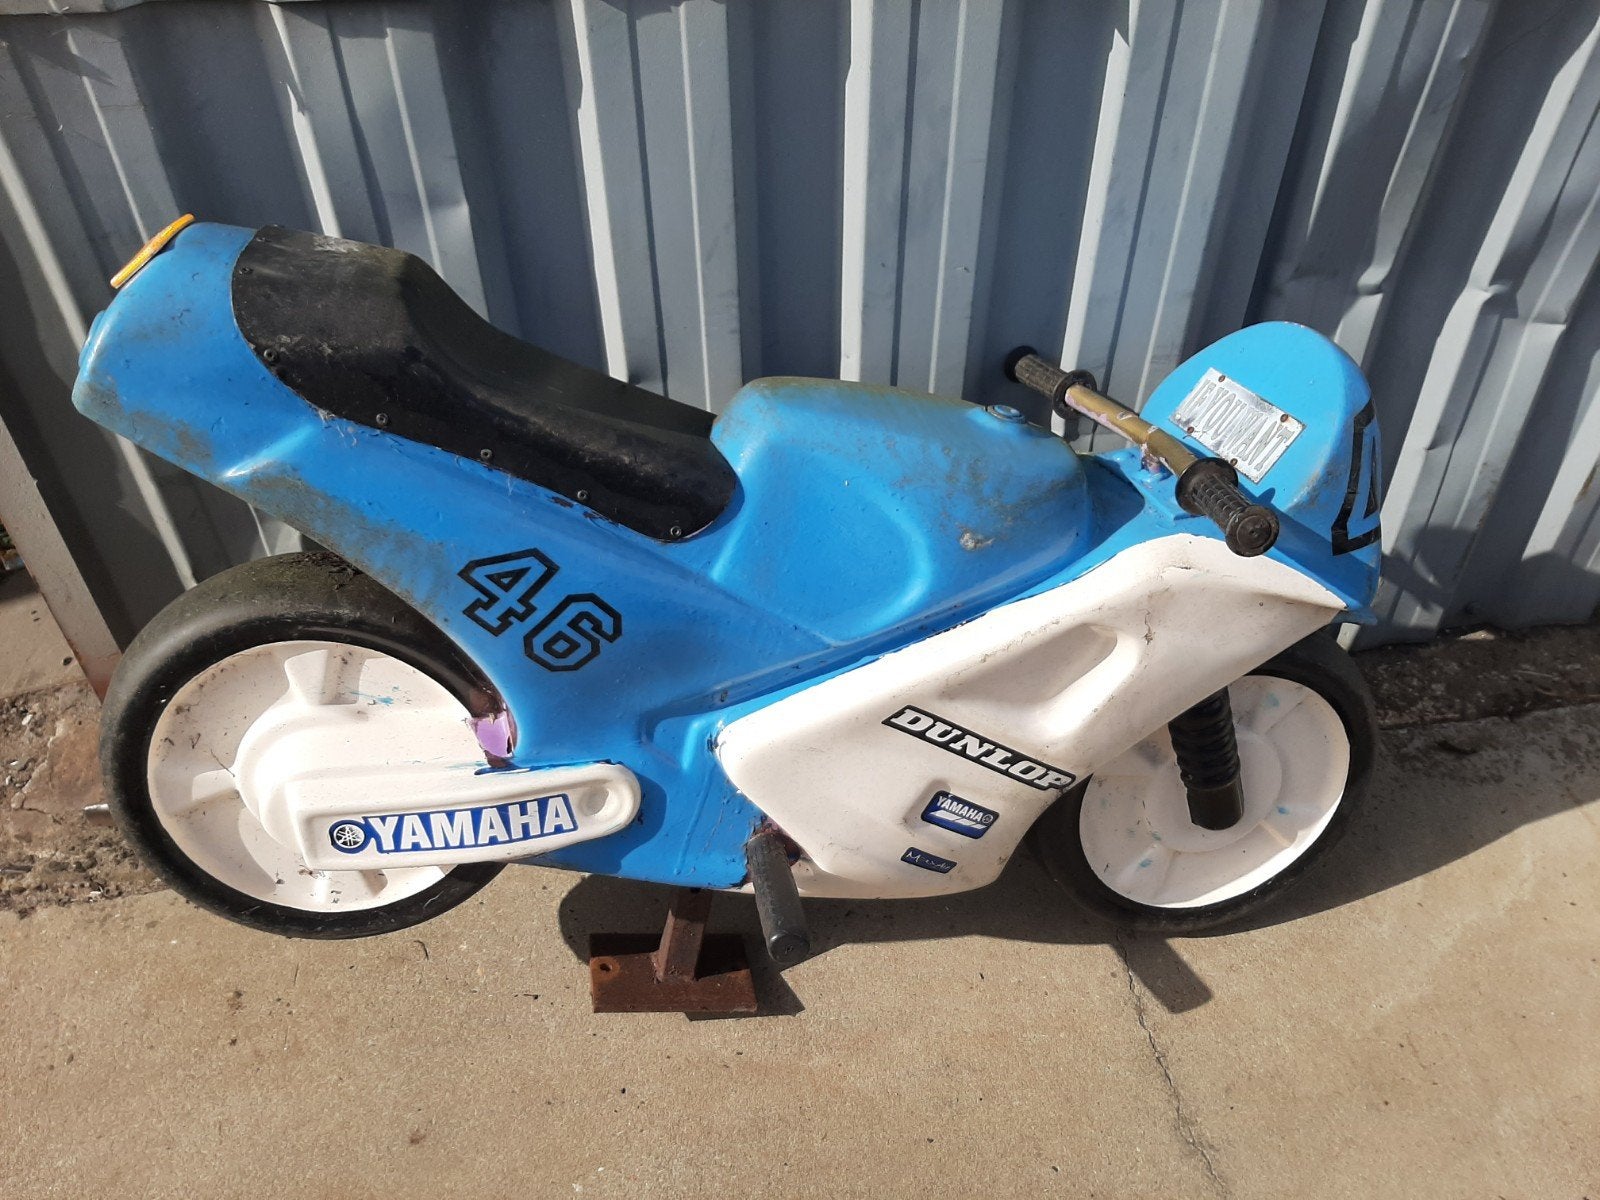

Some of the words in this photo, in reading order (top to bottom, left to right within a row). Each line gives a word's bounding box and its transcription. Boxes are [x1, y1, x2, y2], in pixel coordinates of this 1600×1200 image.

[1179, 379, 1217, 417] IF
[1193, 386, 1247, 441] YOU
[1222, 406, 1296, 472] WANT
[457, 547, 623, 672] 46
[890, 708, 1073, 787] DUNLOP
[369, 796, 576, 851] YAMAHA
[936, 795, 984, 822] YAMAHA
